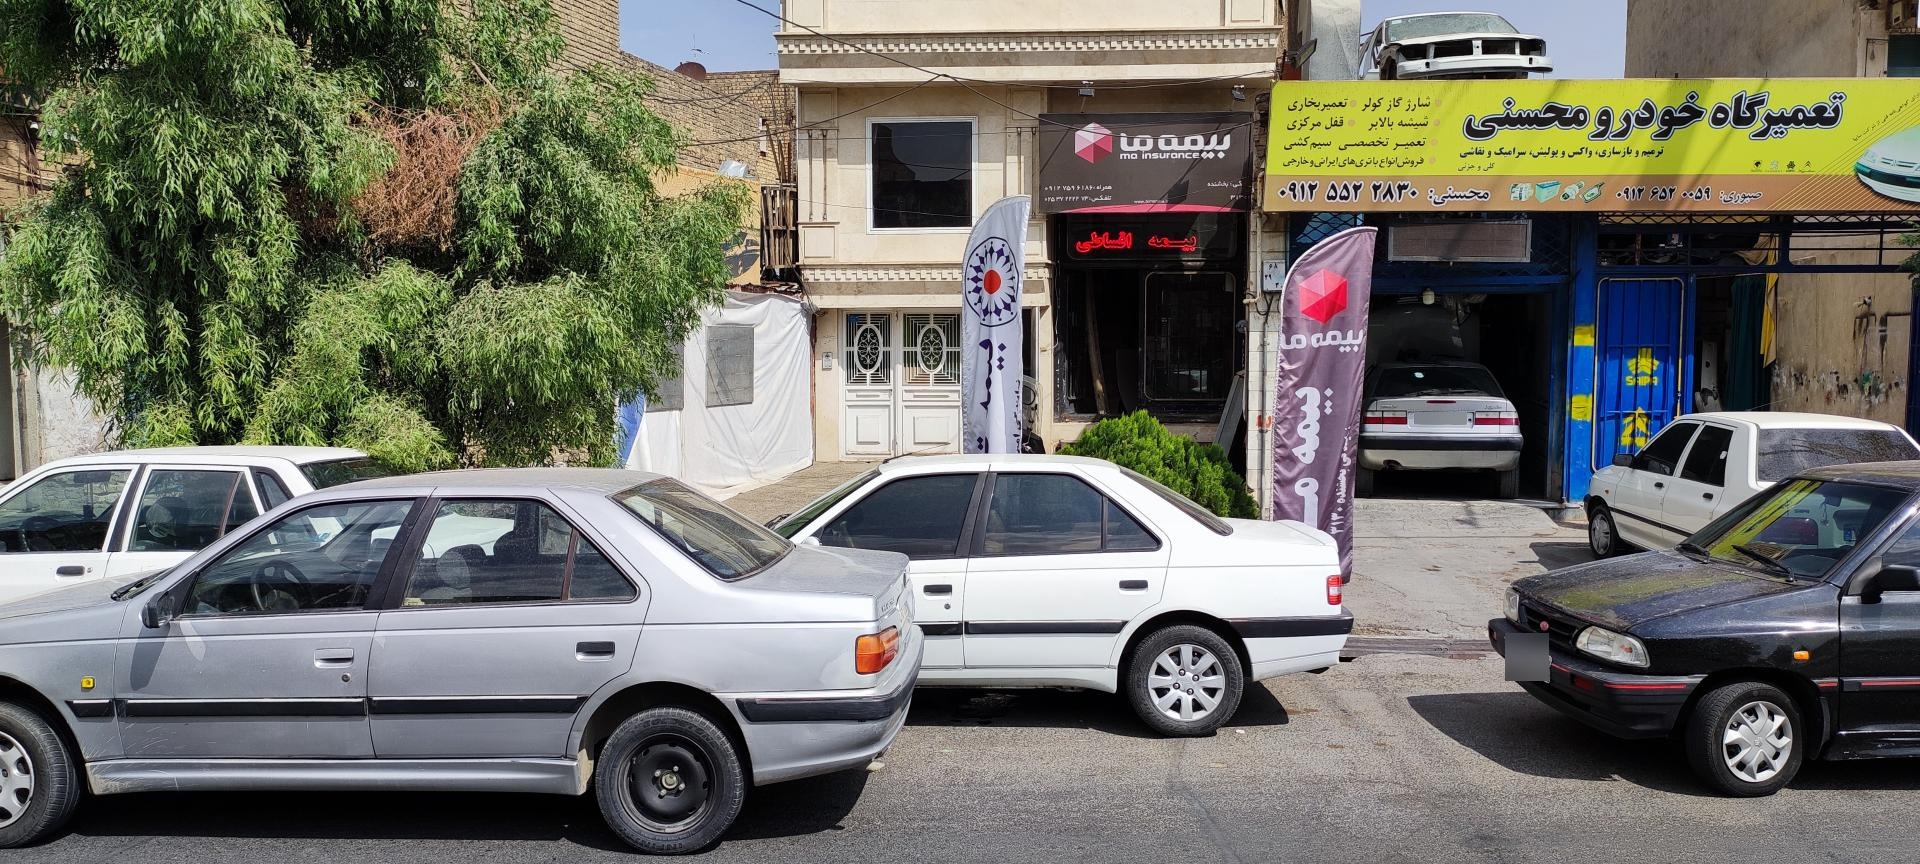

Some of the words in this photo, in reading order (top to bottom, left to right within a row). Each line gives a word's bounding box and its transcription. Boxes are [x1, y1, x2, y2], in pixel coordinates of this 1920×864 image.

[1361, 97, 1384, 112] کولر
[1386, 97, 1403, 112] گاز
[1405, 96, 1431, 112] شارژ
[1287, 116, 1321, 131] مرکزی
[1325, 116, 1344, 130] قفل
[1397, 115, 1429, 129] شیشه
[1463, 97, 1591, 141] محسنی
[1588, 90, 1708, 141] خودرو
[1709, 90, 1847, 141] تعمیرگاه
[1120, 133, 1154, 151] ما
[1158, 133, 1231, 159] بیمه
[1338, 137, 1390, 151] تخصصی
[1392, 137, 1427, 151] تعمیر
[1120, 152, 1138, 160] ma
[1141, 151, 1200, 160] insurance
[1459, 146, 1485, 158] نقاشی
[1494, 147, 1526, 158] سرامیک
[1568, 147, 1592, 158] واکس
[1641, 146, 1664, 158] ترمیم
[1278, 181, 1318, 202] ۰۹۱۲
[1326, 181, 1364, 202] ۵۵۲
[1371, 181, 1418, 202] ۲۸۳۰
[1428, 186, 1490, 206] محسنی:
[1616, 186, 1645, 201] ۰۹۱۲
[1649, 186, 1677, 201] ۶۵۲
[1681, 186, 1711, 201] ۰۰۵۹
[1076, 231, 1132, 253] اقساطی
[1147, 235, 1197, 252] بیمه
[1311, 329, 1363, 353] بیمه
[1292, 386, 1334, 465] بیمه
